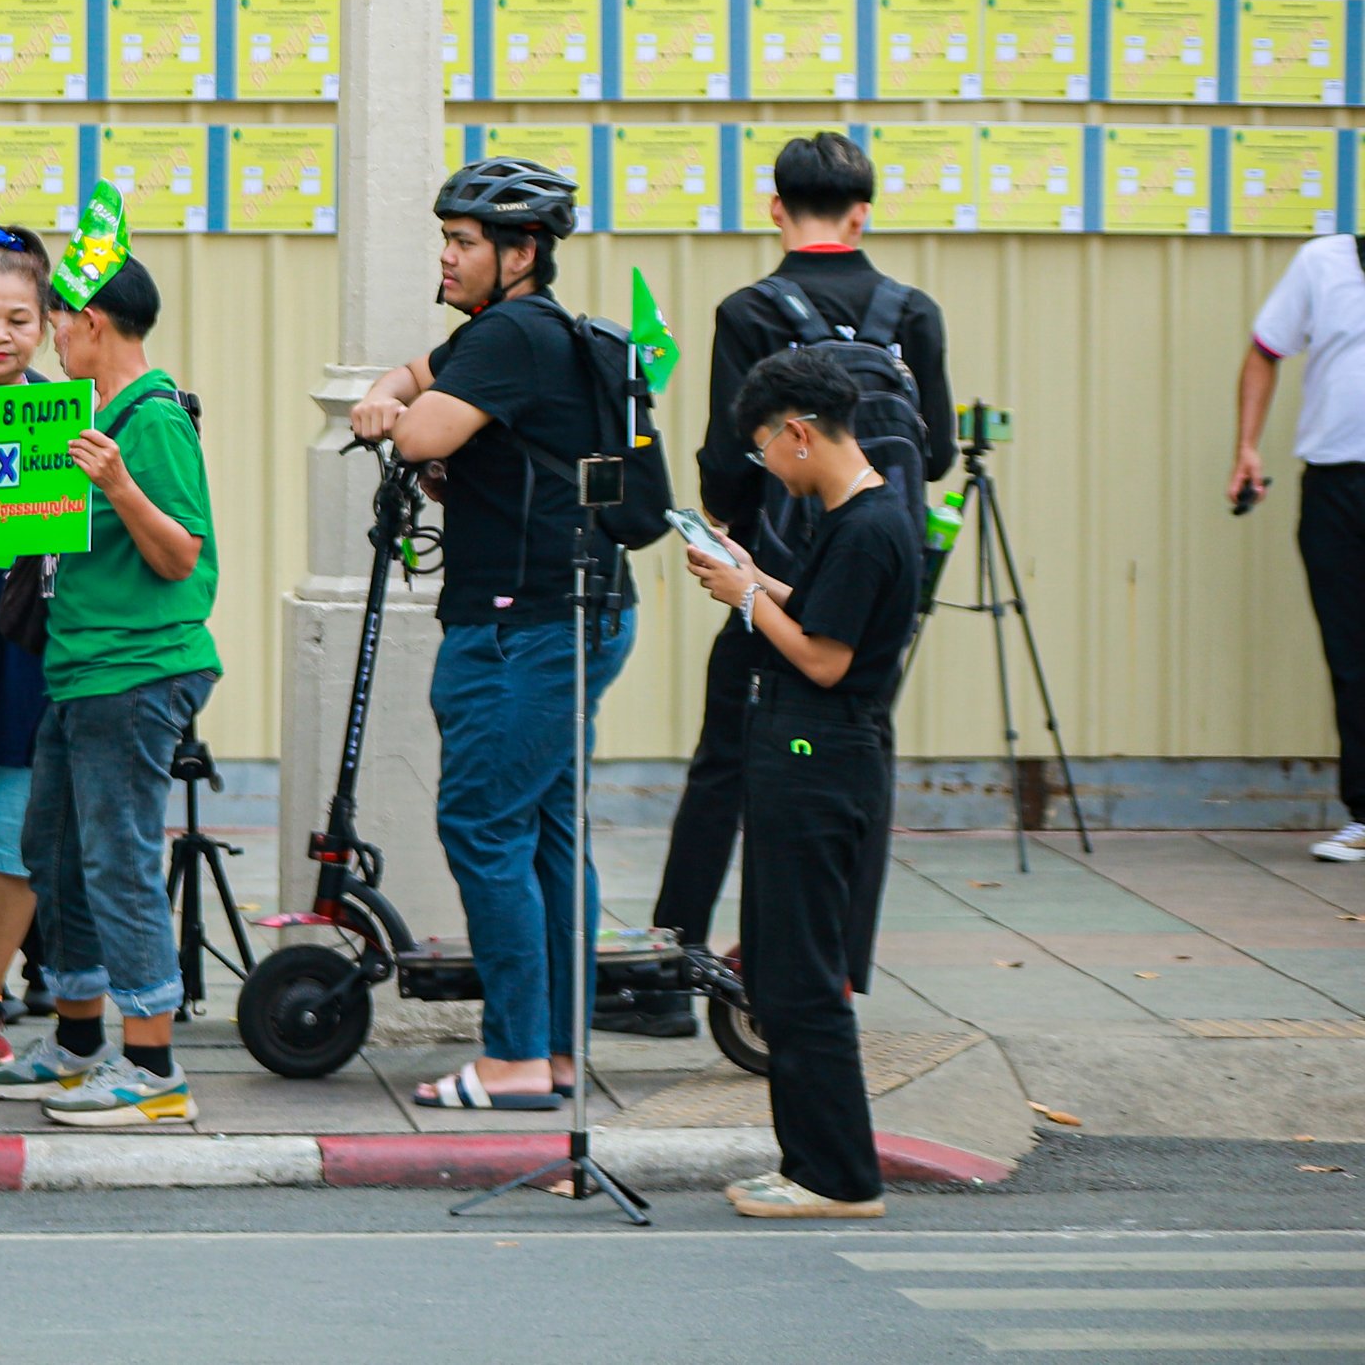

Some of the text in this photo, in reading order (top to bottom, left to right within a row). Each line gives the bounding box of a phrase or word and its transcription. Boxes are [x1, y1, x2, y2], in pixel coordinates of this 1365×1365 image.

[3, 396, 82, 436] 8 กุมภา
[22, 444, 75, 472] เห็นชอ
